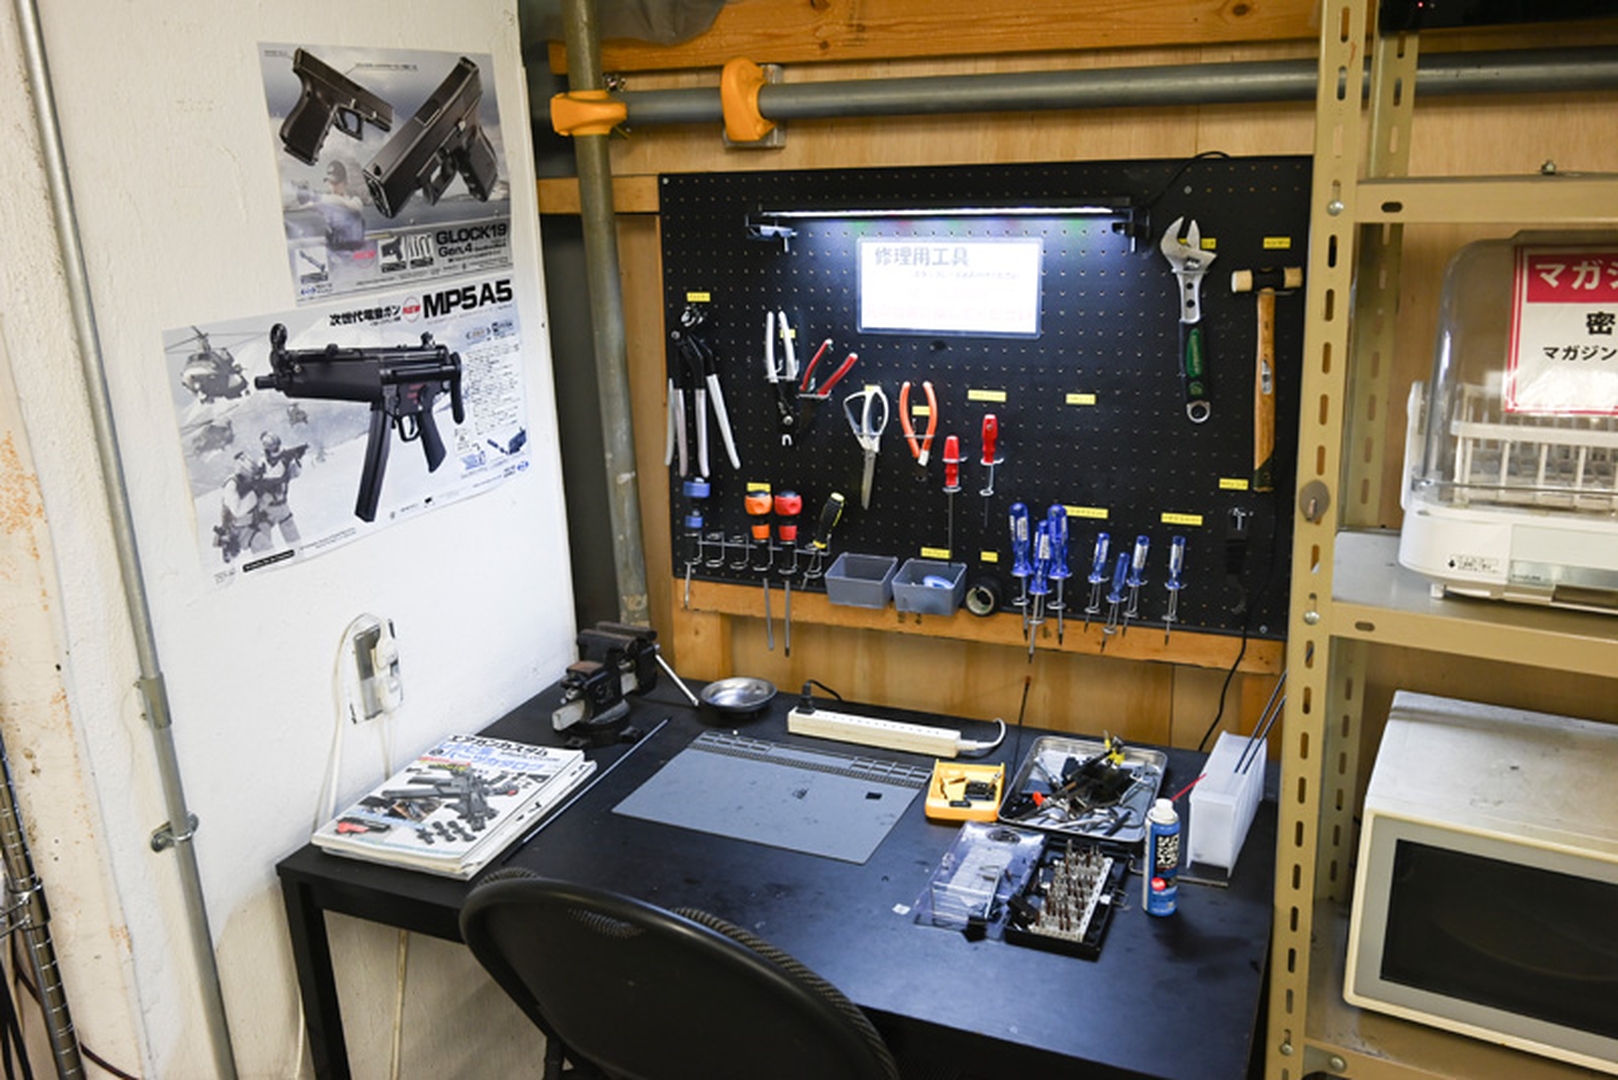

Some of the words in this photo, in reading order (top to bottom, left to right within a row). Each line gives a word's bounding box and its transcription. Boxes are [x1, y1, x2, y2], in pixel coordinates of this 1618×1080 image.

[436, 222, 507, 245] GLOCK19
[438, 243, 473, 257] Gen.4
[875, 246, 969, 266] 修理用工具
[423, 279, 513, 319] MP5A5
[329, 305, 402, 326] 次世代電動ガン
[1586, 311, 1616, 336] 密
